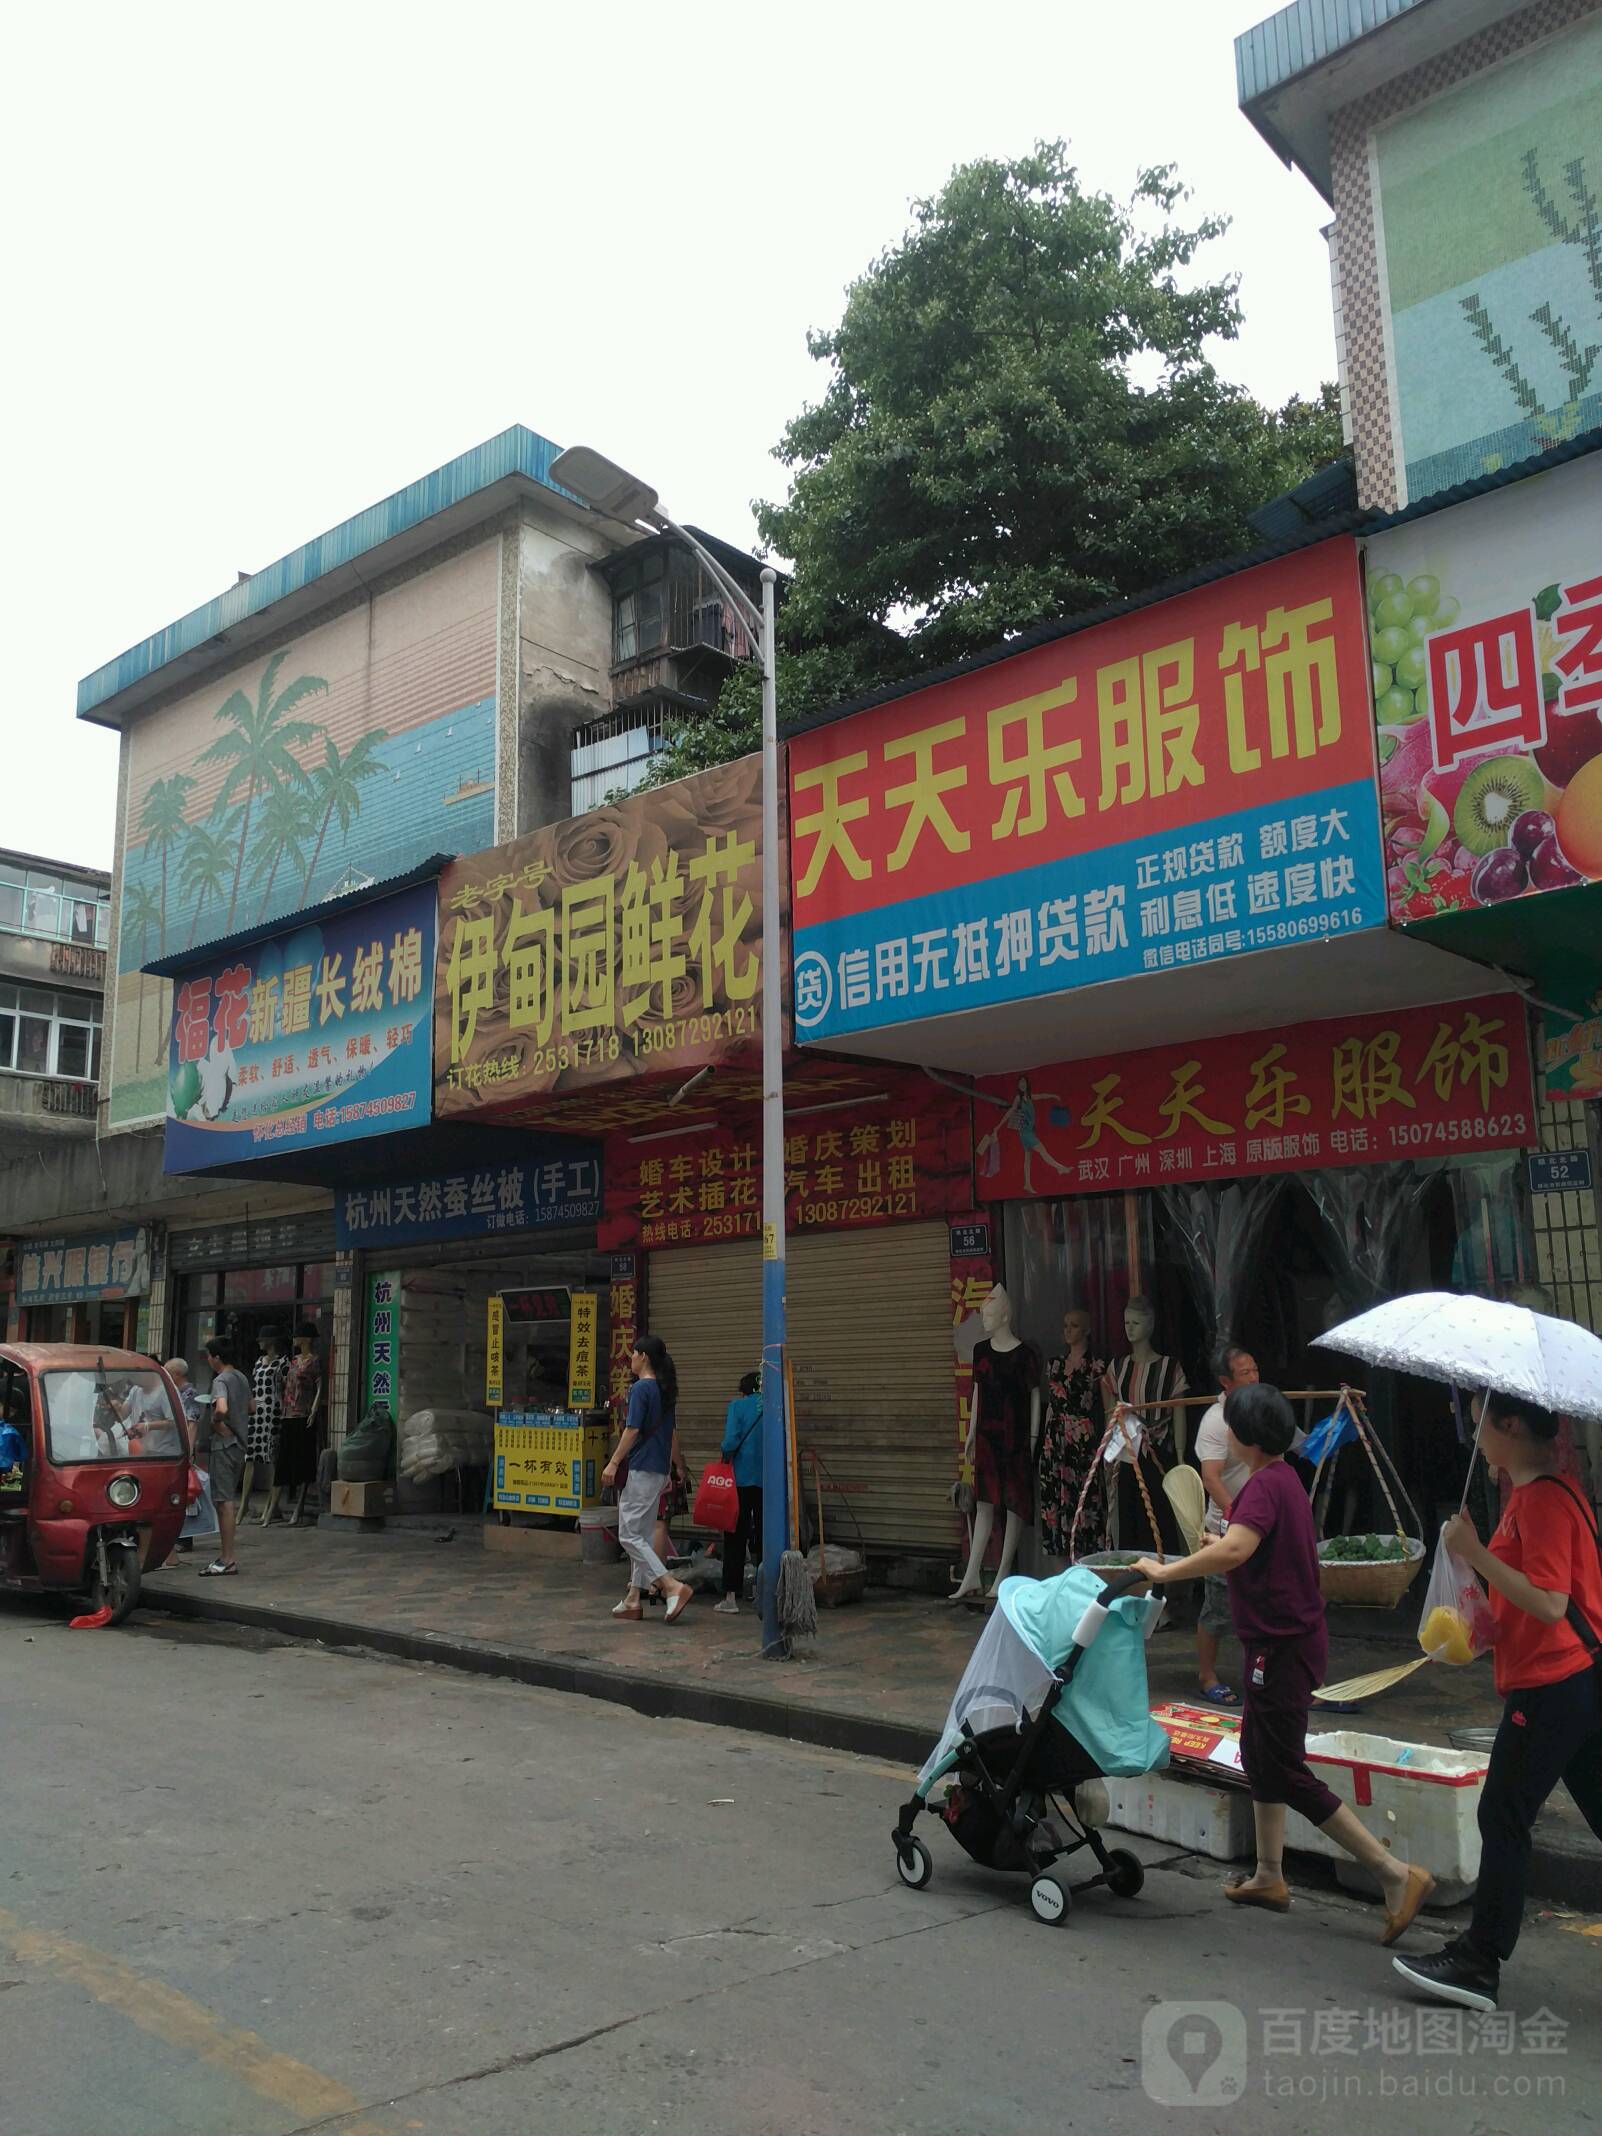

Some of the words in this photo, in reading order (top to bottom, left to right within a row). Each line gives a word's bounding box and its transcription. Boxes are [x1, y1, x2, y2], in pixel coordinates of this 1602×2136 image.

[793, 597, 1342, 899] 天天乐服饰
[450, 861, 554, 910] 老字号
[1136, 832, 1245, 890] 正规贷款
[1259, 808, 1350, 860] 额度大
[1140, 879, 1237, 938] 利息低
[1247, 855, 1356, 915] 速度快
[249, 927, 423, 1044] 新疆长绒棉
[446, 830, 760, 1065] 伊甸园鲜花
[838, 884, 1129, 1010] 信用无抵押贷款
[175, 962, 251, 1064] 福花
[632, 1006, 756, 1057] 13087292121
[1076, 1012, 1510, 1151] 天天乐服饰
[639, 1144, 757, 1187] 婚车设计
[639, 1177, 758, 1220] 艺术插花
[1078, 1158, 1110, 1182] 武汉
[1119, 1153, 1151, 1177] 广州
[1159, 1150, 1193, 1172] 深圳
[1201, 1143, 1237, 1168] 上海
[1246, 1133, 1320, 1163] 原版服饰
[1550, 1165, 1570, 1179] 52
[797, 1192, 918, 1226] 13087292121
